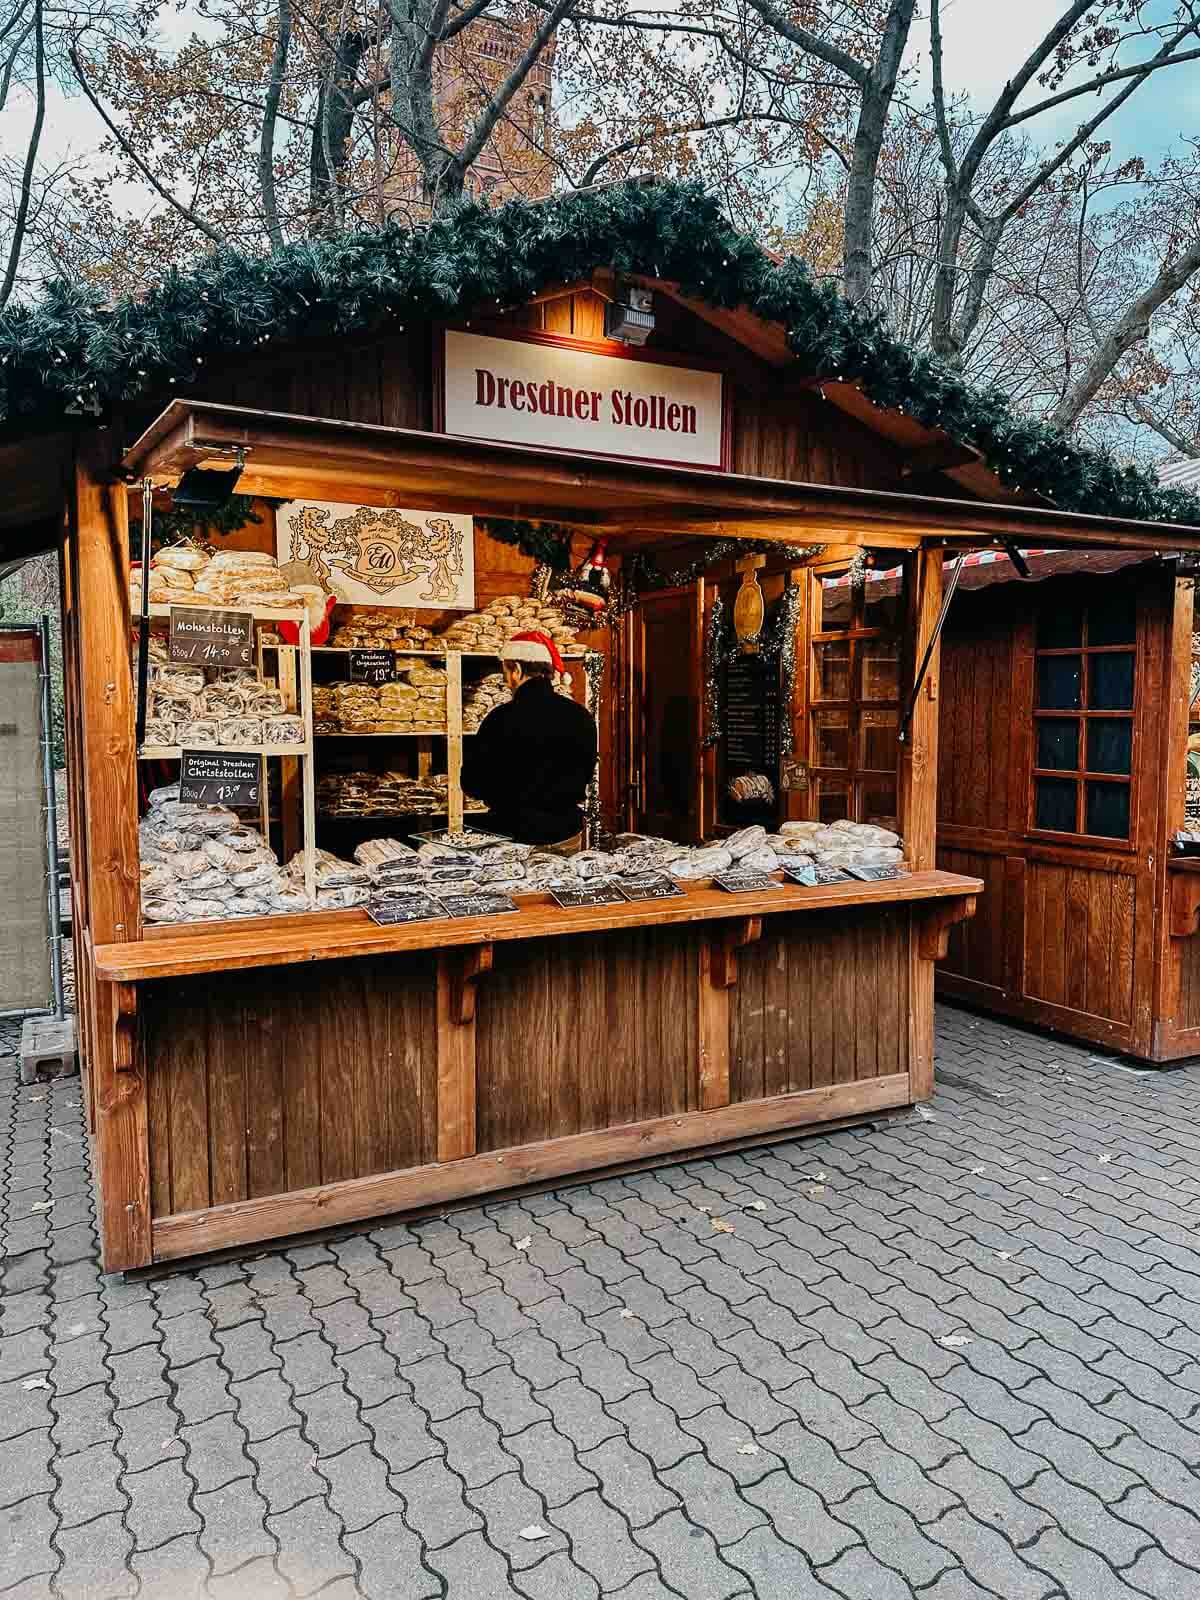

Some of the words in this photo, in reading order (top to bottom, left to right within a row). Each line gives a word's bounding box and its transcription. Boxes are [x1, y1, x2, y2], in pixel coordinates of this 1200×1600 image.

[475, 369, 602, 421] Dresdner
[612, 389, 697, 434] Stollen
[177, 621, 245, 635] Mohnstollen
[240, 649, 249, 661] €
[188, 758, 220, 767] Original
[222, 760, 256, 768] Dresdner
[188, 767, 254, 778] Christstollen
[249, 787, 257, 800] €
